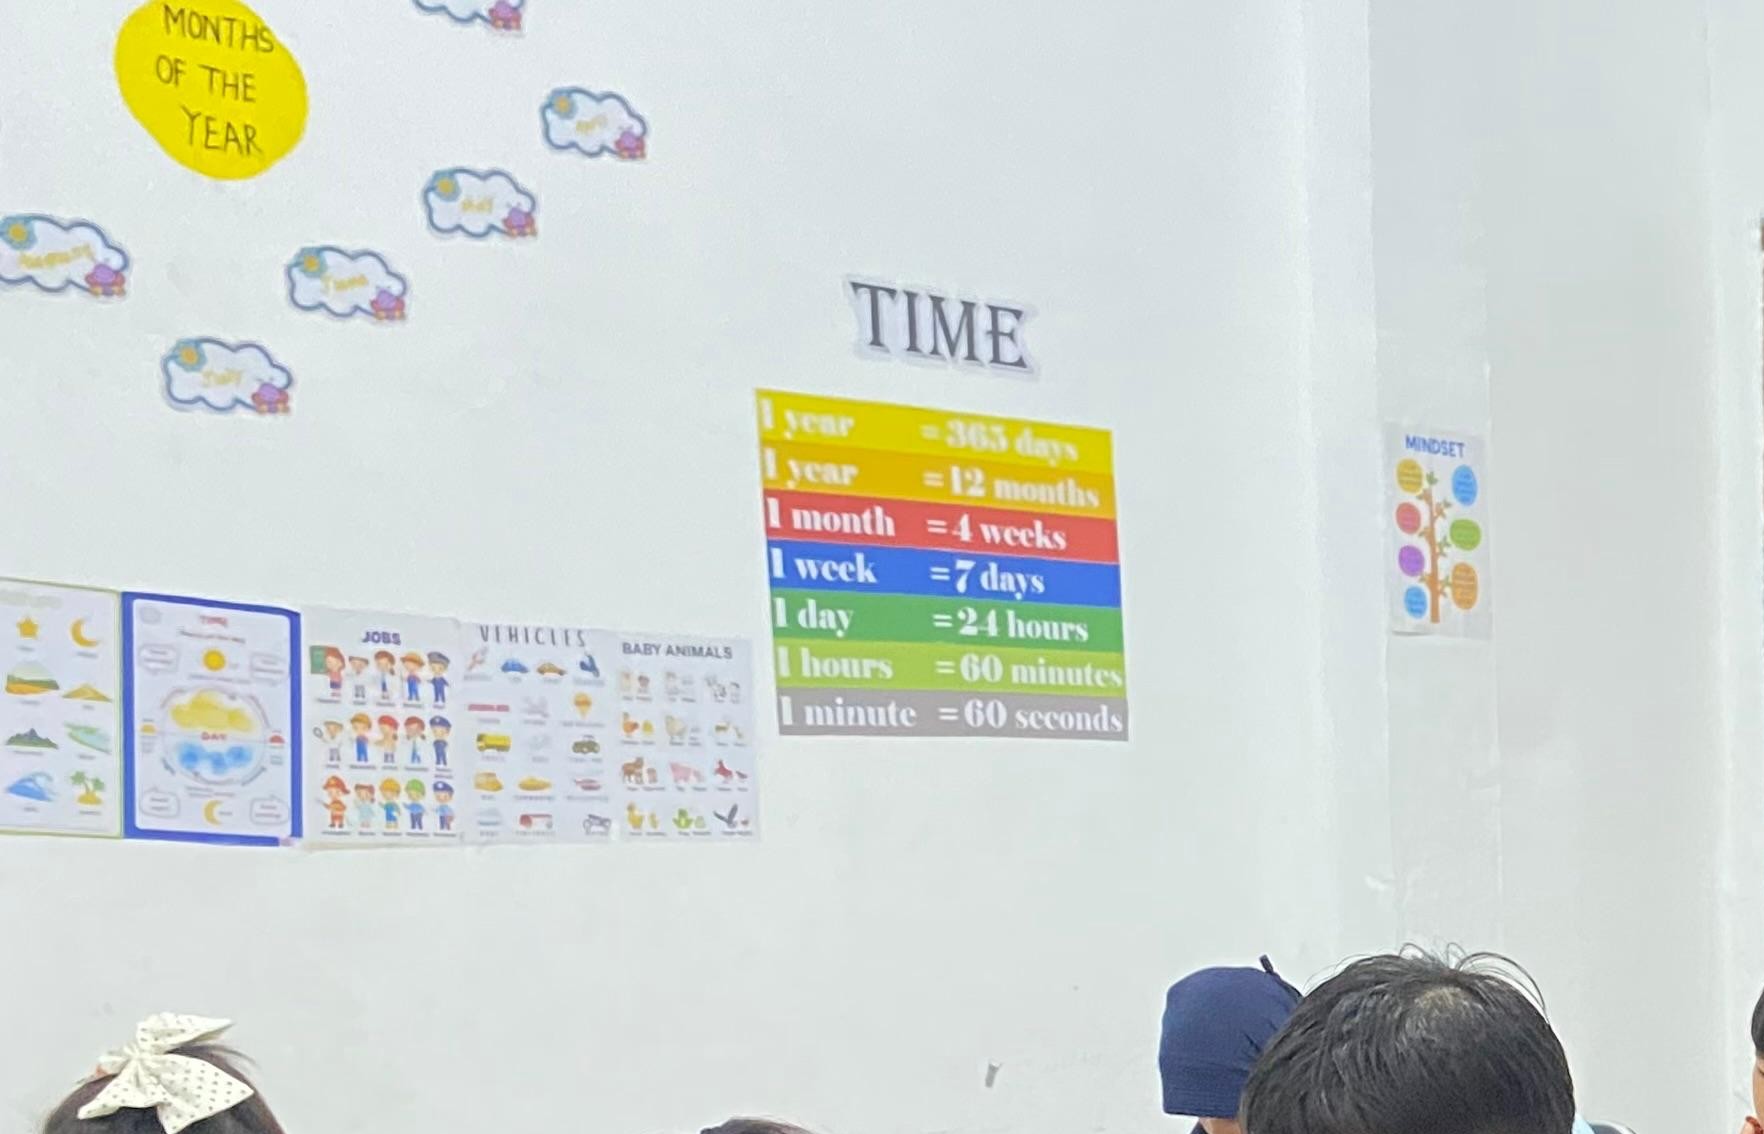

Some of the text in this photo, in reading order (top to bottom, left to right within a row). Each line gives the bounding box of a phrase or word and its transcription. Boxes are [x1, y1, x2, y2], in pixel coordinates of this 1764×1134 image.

[163, 3, 274, 53] MONTHS
[156, 54, 256, 103] OF THE
[180, 103, 264, 156] YEAR
[851, 281, 1027, 369] TIME
[759, 399, 773, 429] 1
[784, 411, 854, 440] year
[1016, 428, 1078, 466] days
[1405, 434, 1464, 458] MINDSET
[763, 447, 777, 478] 1
[787, 459, 858, 488] year
[994, 477, 1099, 509] months
[767, 497, 781, 528] 1
[792, 505, 895, 537] month
[980, 520, 1067, 551] weeks
[770, 548, 785, 578] 1
[795, 552, 878, 584] week
[980, 562, 1045, 599] days
[361, 631, 401, 646] JOBS
[774, 597, 787, 628] 1
[798, 599, 853, 637] day
[1007, 610, 1088, 642] hours
[622, 642, 733, 660] BABY ANIMALS
[776, 646, 790, 677] 1
[801, 646, 893, 678] hours
[1011, 657, 1123, 687] minutes
[780, 696, 792, 725] 1
[804, 698, 917, 727] minute
[1015, 705, 1123, 732] seconds
